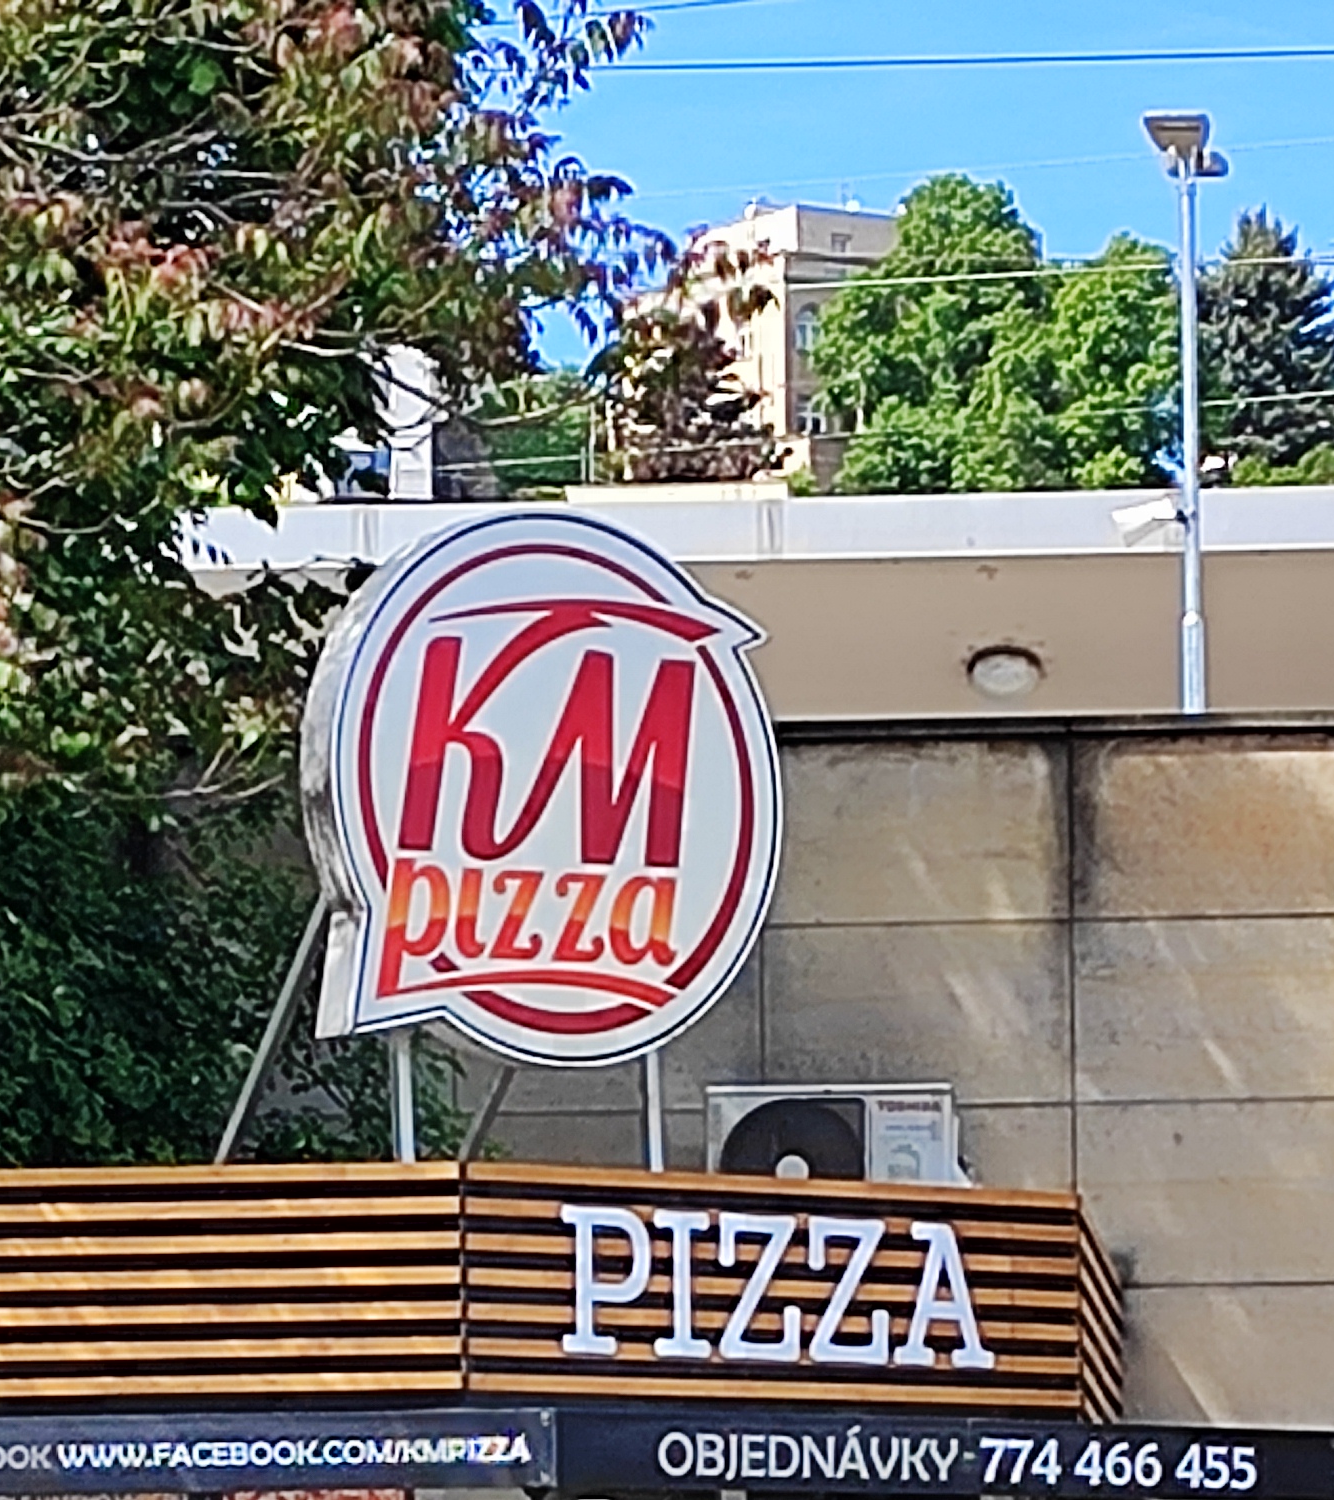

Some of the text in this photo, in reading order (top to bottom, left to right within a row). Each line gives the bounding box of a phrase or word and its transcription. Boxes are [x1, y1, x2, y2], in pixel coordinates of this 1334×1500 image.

[398, 600, 722, 868] KM
[376, 858, 680, 1000] pizza
[560, 1203, 996, 1369] PIZZA
[979, 1436, 1061, 1485] 774
[1074, 1440, 1162, 1488] 466
[1176, 1445, 1258, 1491] 455
